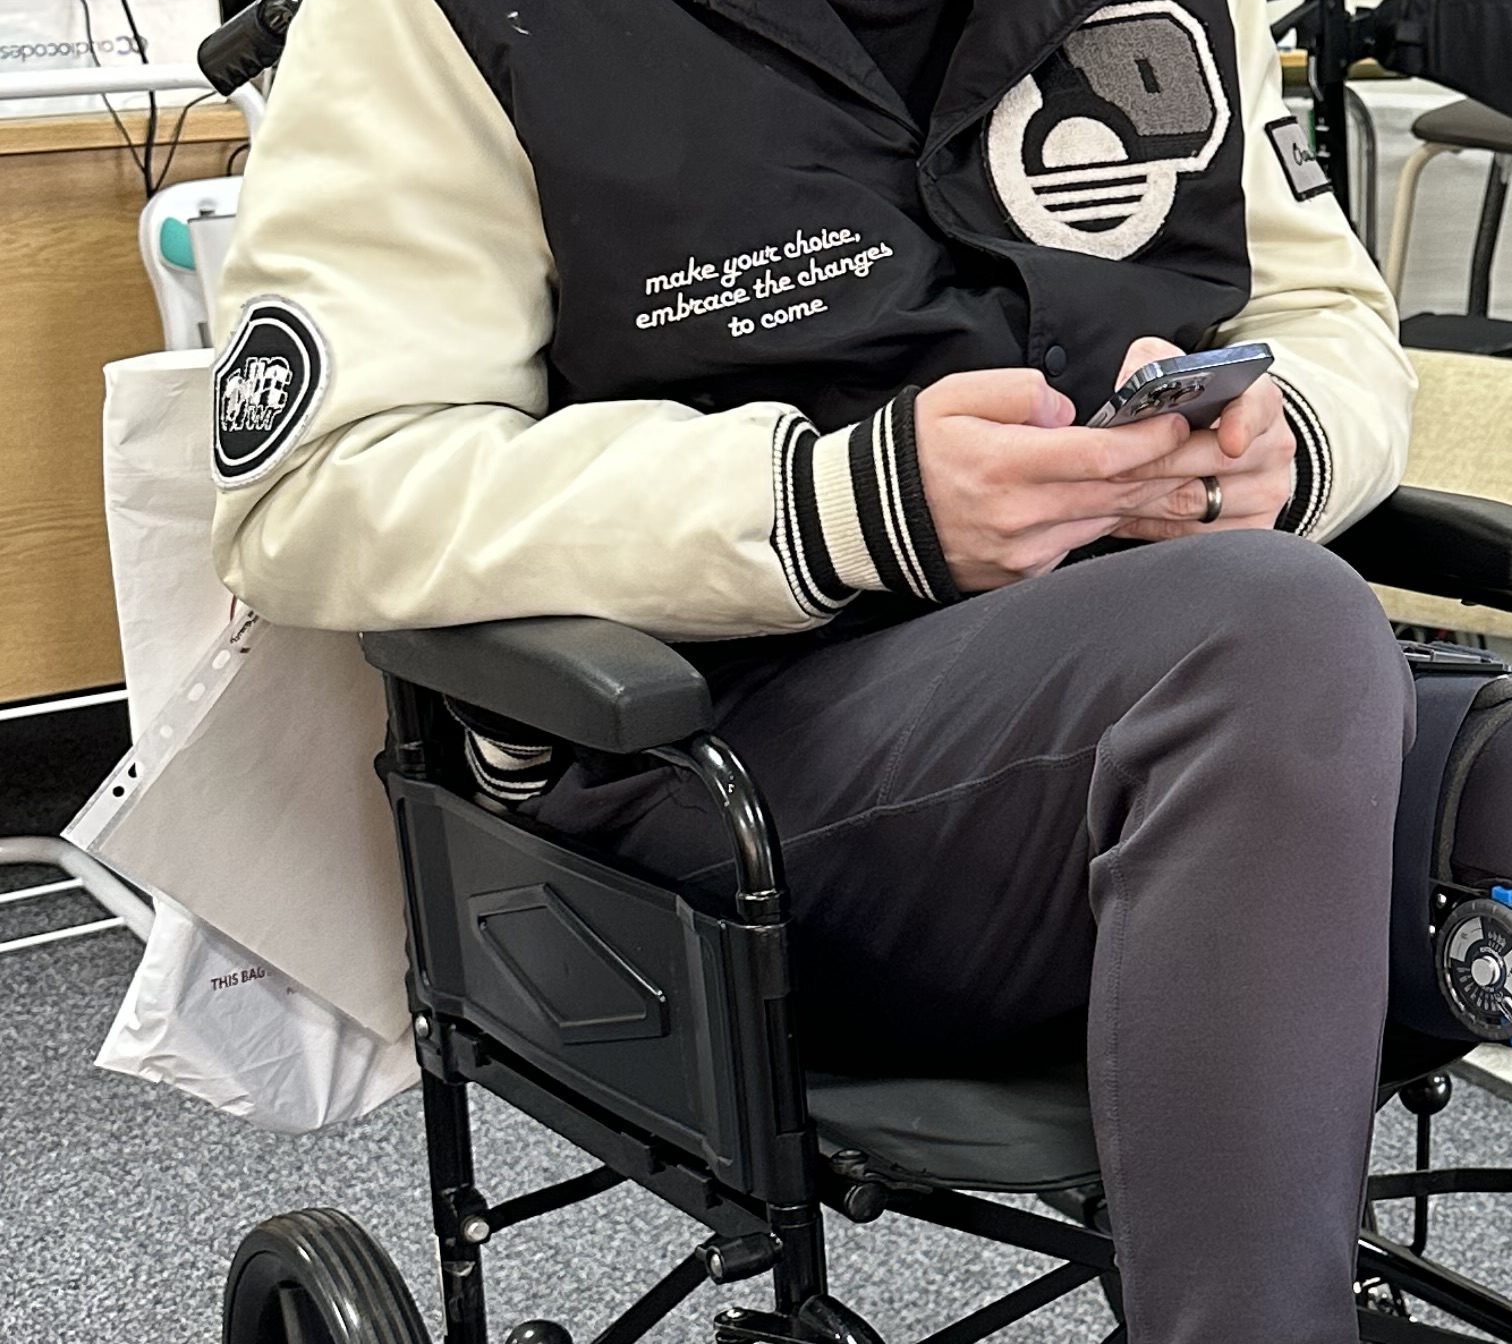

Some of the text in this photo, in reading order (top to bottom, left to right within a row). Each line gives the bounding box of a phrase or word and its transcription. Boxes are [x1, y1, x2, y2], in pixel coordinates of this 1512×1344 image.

[635, 241, 895, 331] embrace the changes
[644, 228, 862, 296] make your choice,
[728, 297, 829, 338] to come
[210, 966, 267, 992] THIS BAG
